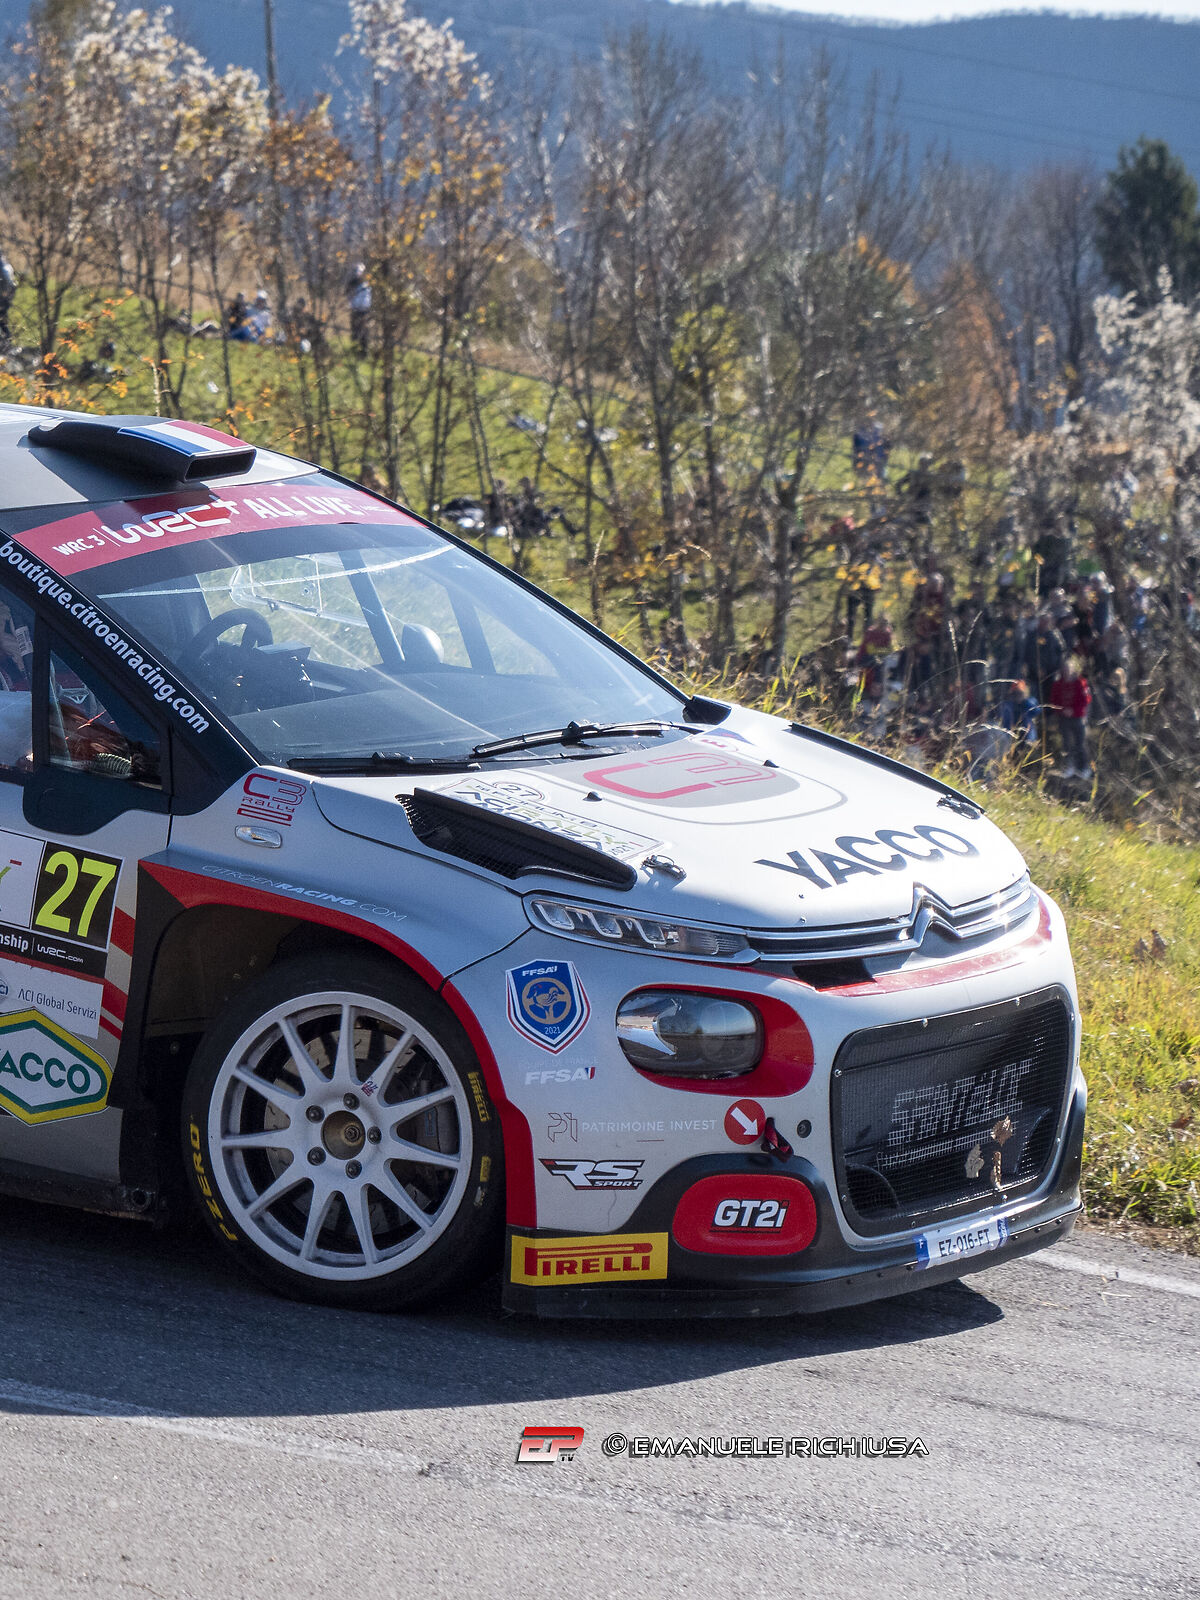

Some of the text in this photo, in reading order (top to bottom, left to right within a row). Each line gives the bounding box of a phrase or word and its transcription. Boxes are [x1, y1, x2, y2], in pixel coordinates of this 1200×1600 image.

[242, 496, 298, 519] ALL
[291, 496, 365, 516] LIVE
[52, 534, 106, 556] WRC 3
[243, 773, 307, 806] C3
[752, 823, 981, 890] YACCO
[34, 850, 118, 938] 27
[17, 987, 98, 1020] ACI Global Servizi
[581, 1119, 718, 1133] PATRIMOINE INVEST
[593, 1179, 643, 1187] SPORT
[712, 1199, 790, 1228] GT2i
[524, 1242, 654, 1276] PIRELLI
